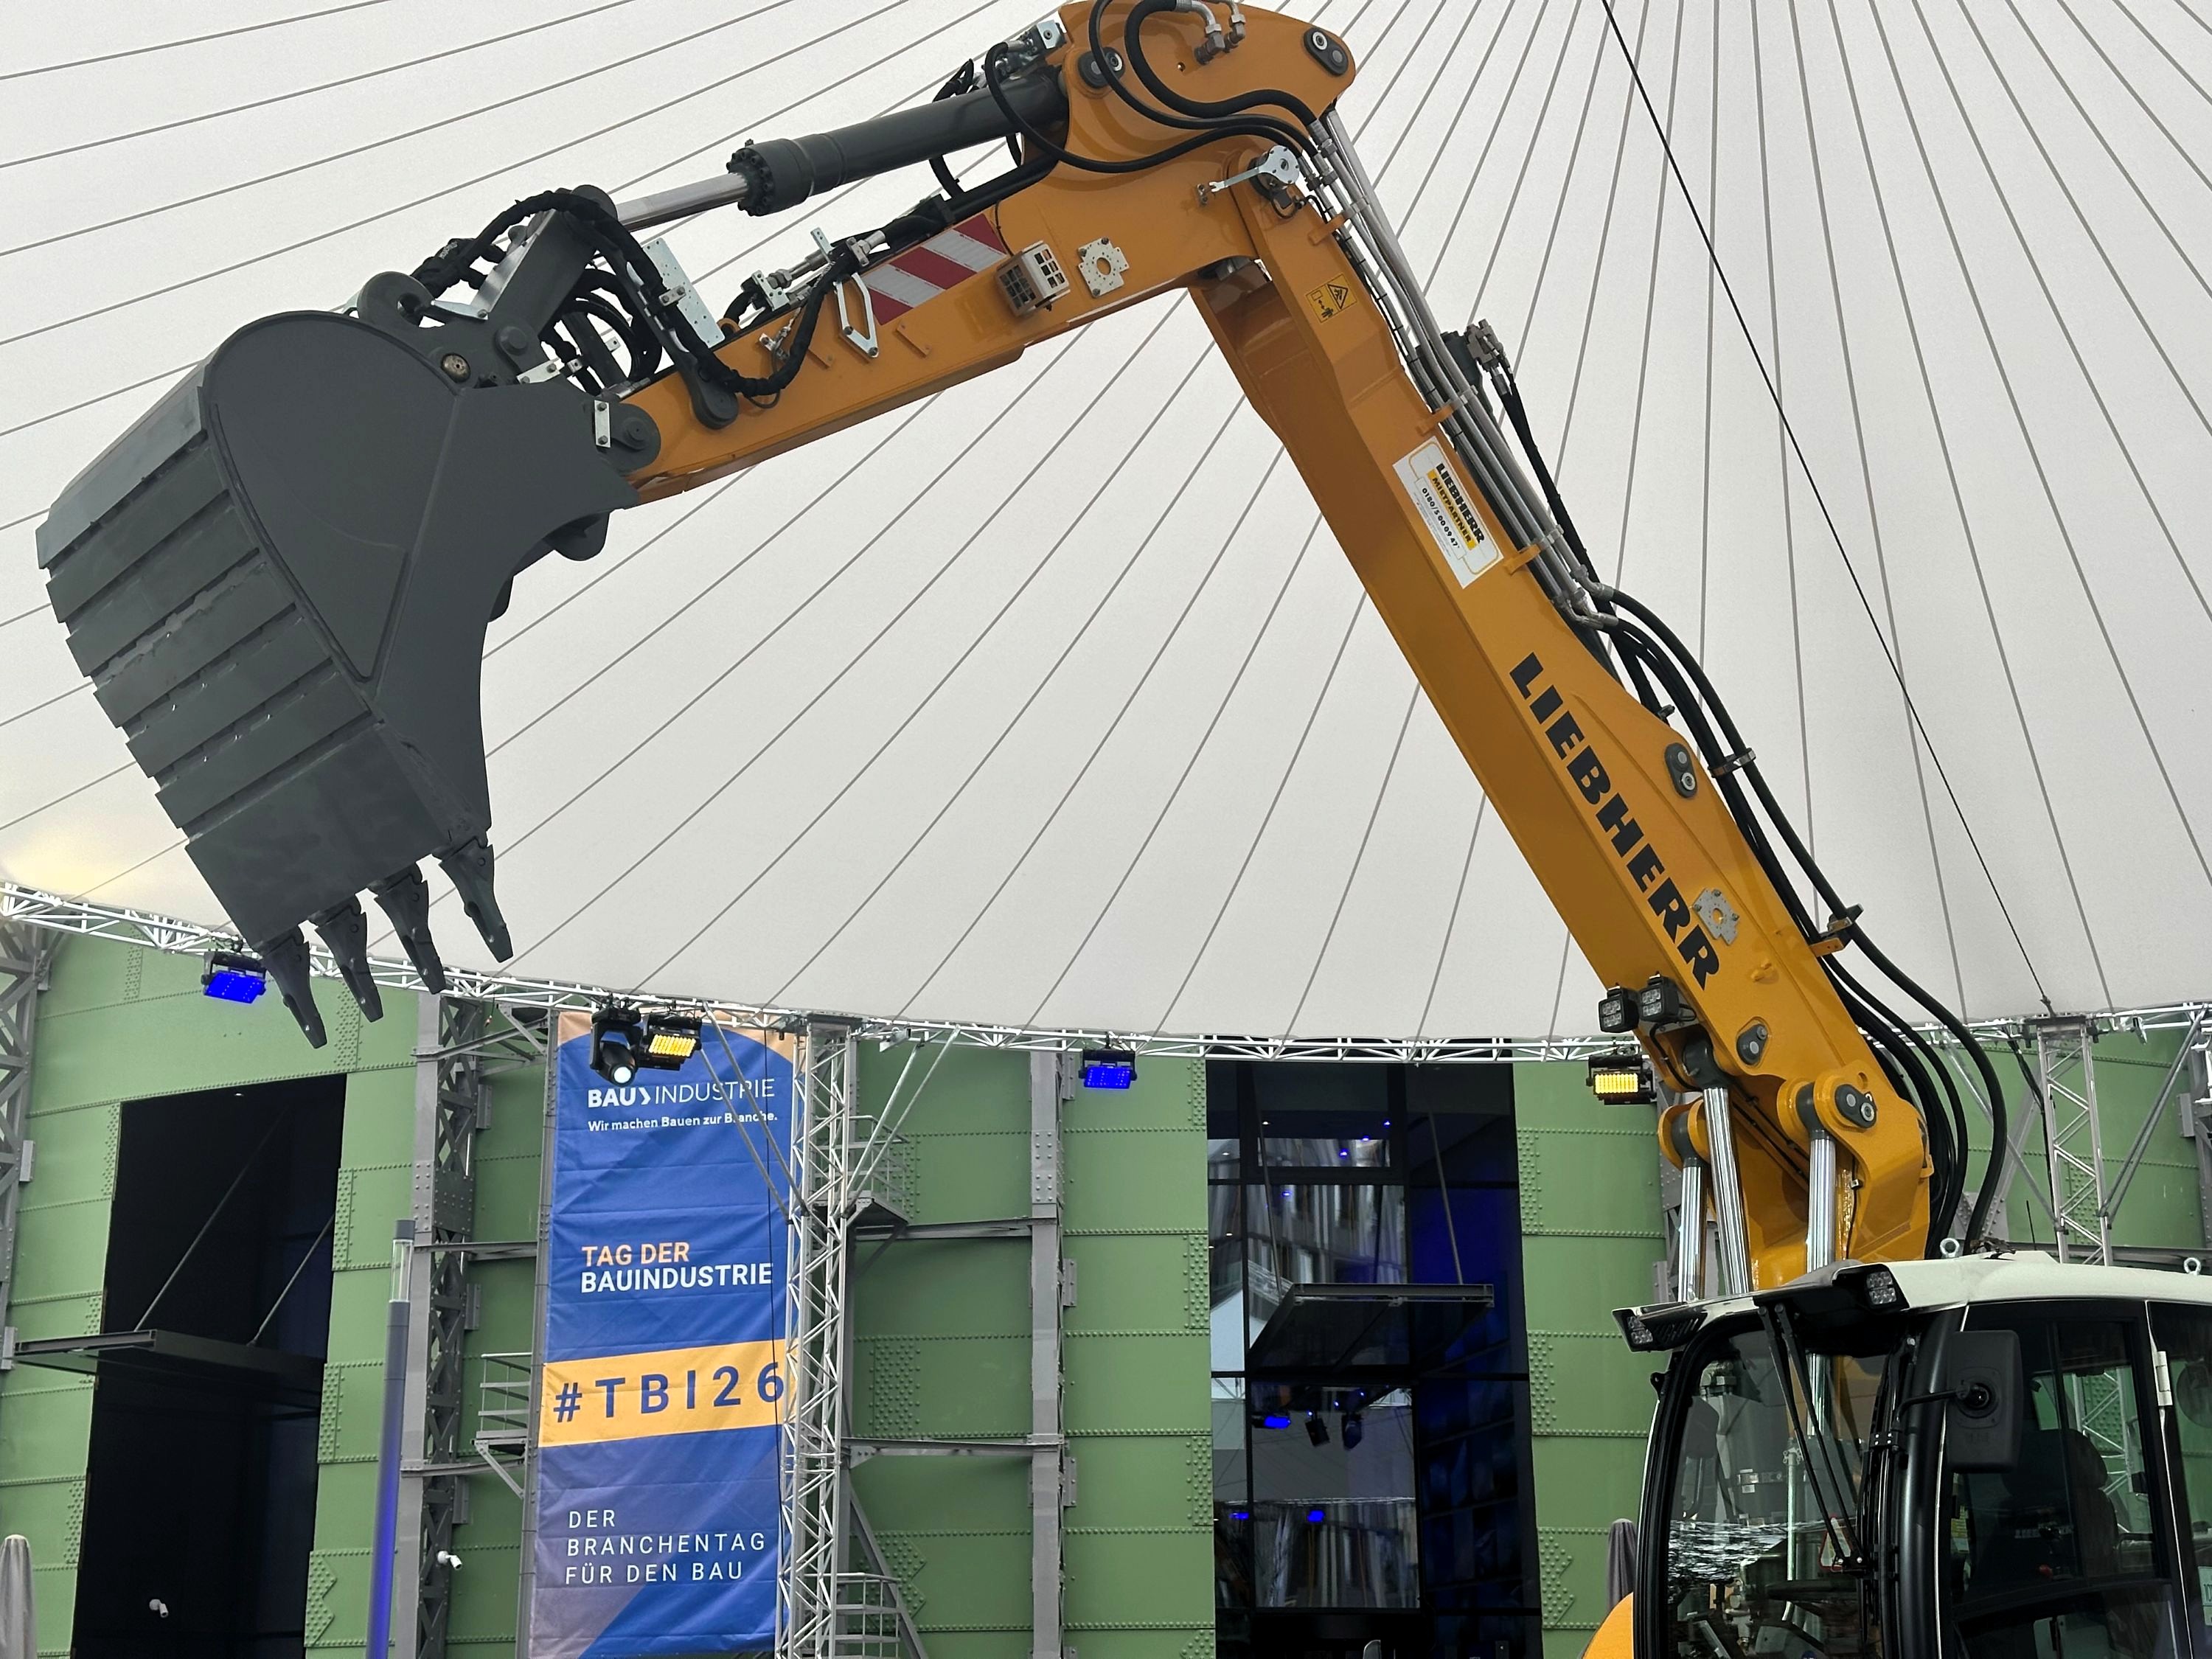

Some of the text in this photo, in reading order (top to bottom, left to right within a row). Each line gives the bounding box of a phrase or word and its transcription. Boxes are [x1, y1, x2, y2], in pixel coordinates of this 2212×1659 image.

[1433, 478, 1472, 543] MIETPARTNER
[1436, 463, 1485, 543] LIEBHERR
[1509, 652, 1719, 991] LIEBHERR
[588, 1110, 778, 1132] Wir machen Bauen zur Banche.
[581, 1242, 690, 1267] TAG DER
[581, 1262, 773, 1293] BAUINDUSTRIE
[553, 1362, 785, 1423] #TBI26
[568, 1509, 616, 1528] DER
[567, 1532, 765, 1557] BRANCHENTAG
[566, 1561, 742, 1585] FÜR DEN BAU
